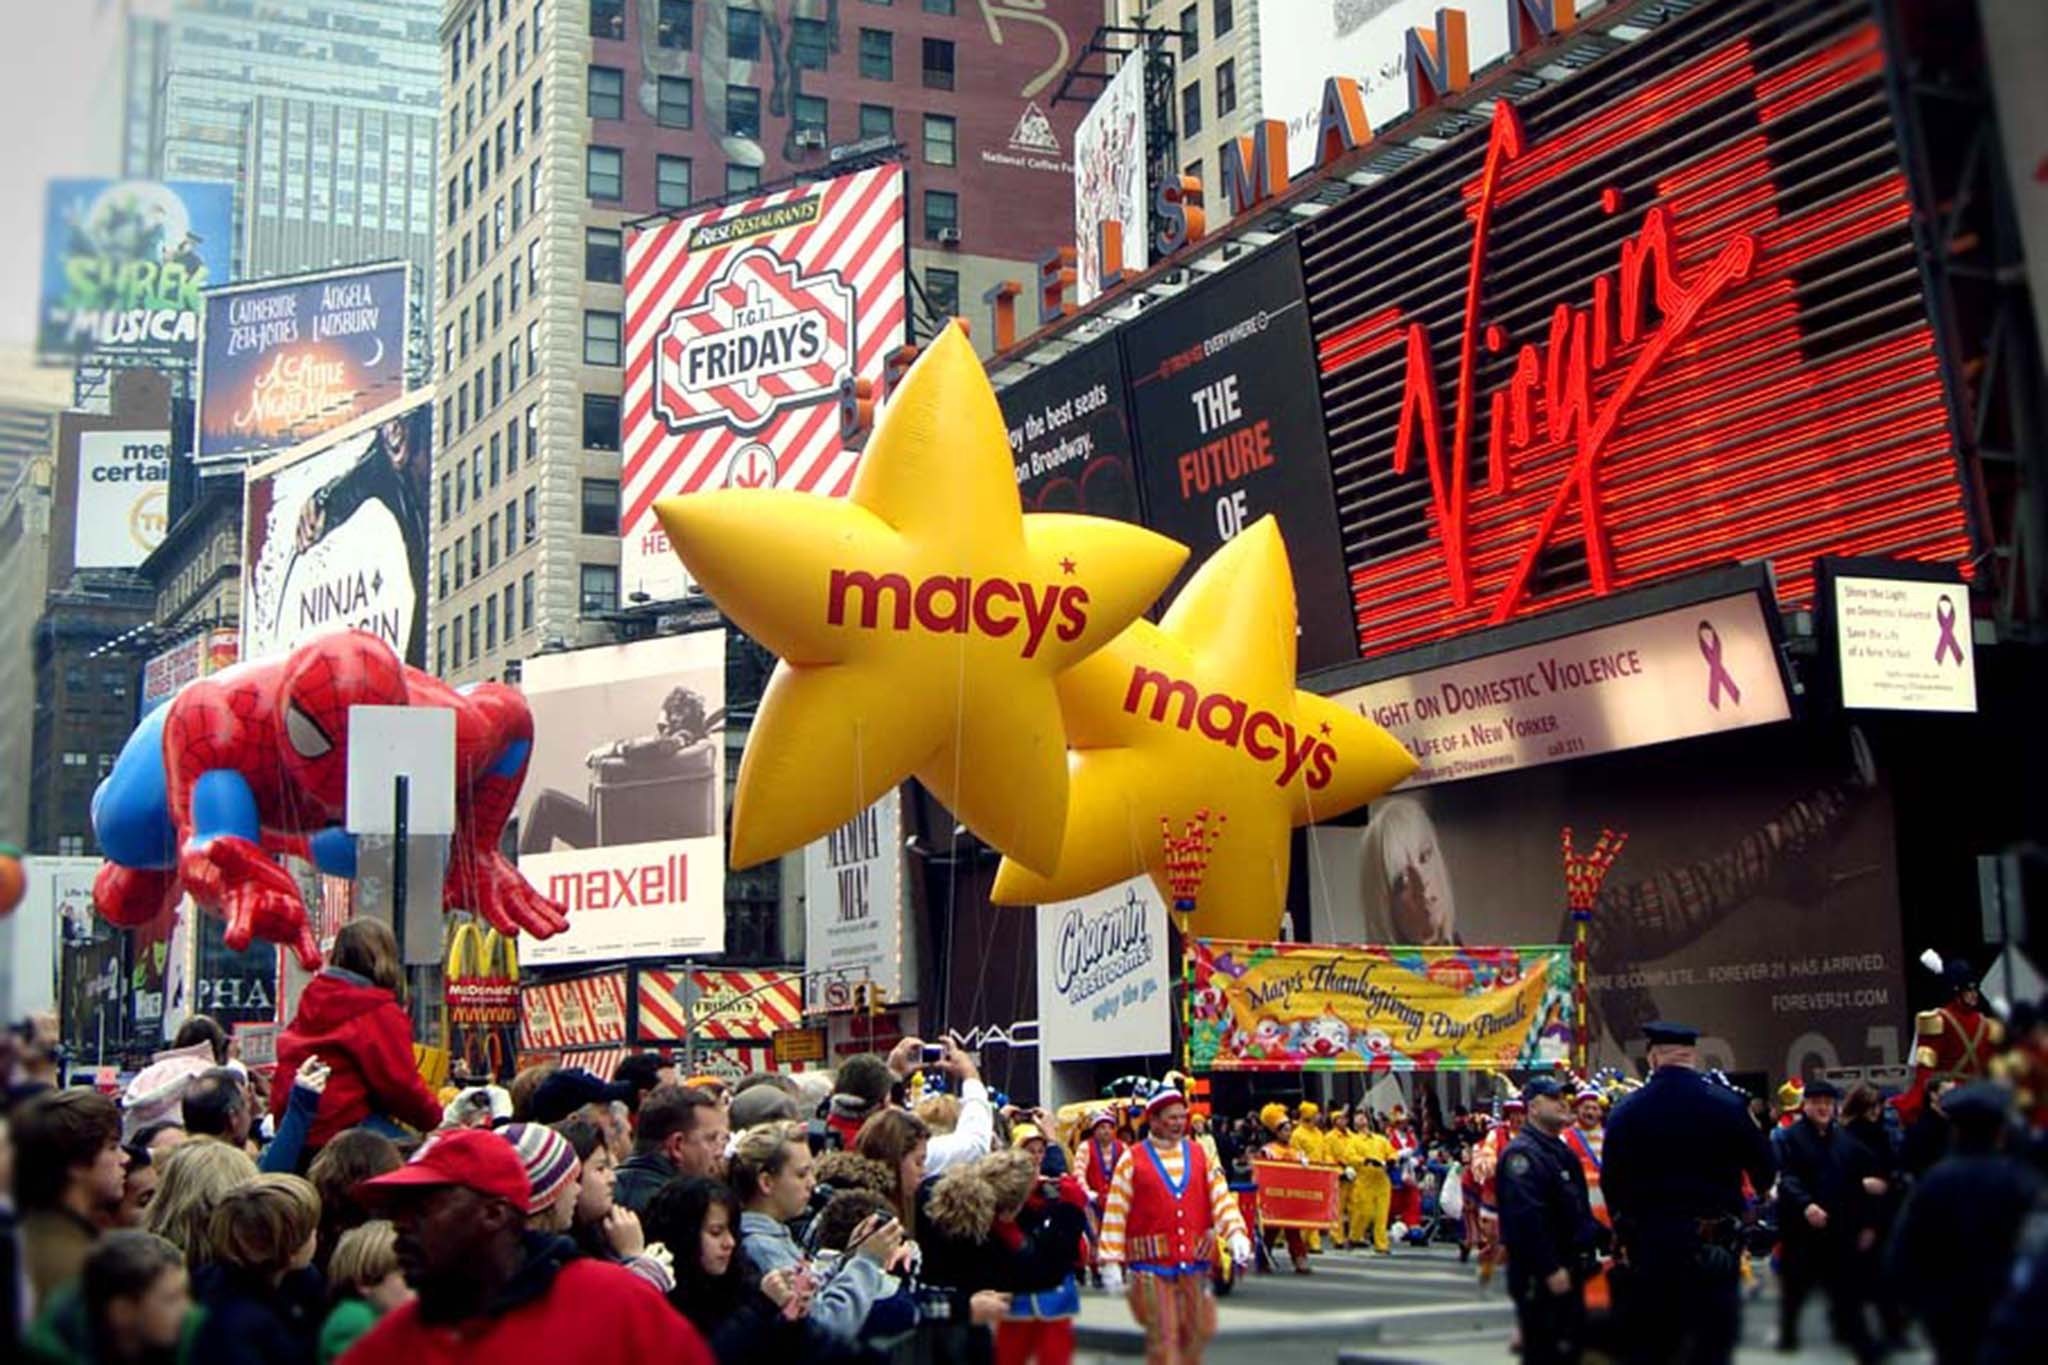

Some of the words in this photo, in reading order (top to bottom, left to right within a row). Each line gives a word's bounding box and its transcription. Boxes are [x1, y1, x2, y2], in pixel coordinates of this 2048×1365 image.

[313, 307, 379, 342] LANSBURY
[321, 282, 372, 311] ANGELA
[1393, 100, 1753, 625] Virgin
[1007, 425, 1026, 453] oy
[1025, 412, 1046, 440] the
[1046, 400, 1074, 431] best
[1075, 384, 1108, 418] seats
[1191, 373, 1243, 435] THE
[1178, 420, 1275, 499] FUTURE
[642, 534, 673, 556] HE
[1216, 490, 1248, 541] OF
[300, 570, 368, 630] NINJA
[1416, 694, 1442, 720] ON
[1442, 672, 1541, 716] DOMESTIC
[1538, 649, 1643, 695] VIOLENCE
[1412, 734, 1441, 758] LIFE
[1442, 735, 1458, 752] OF
[1470, 724, 1502, 747] NEW
[1502, 715, 1560, 739] YORKER
[550, 853, 688, 912] maxell
[1056, 887, 1148, 994] Charmin
[1308, 955, 1425, 1041] Thanksgiving
[1429, 1011, 1471, 1056] Day
[1473, 991, 1529, 1040] Parade
